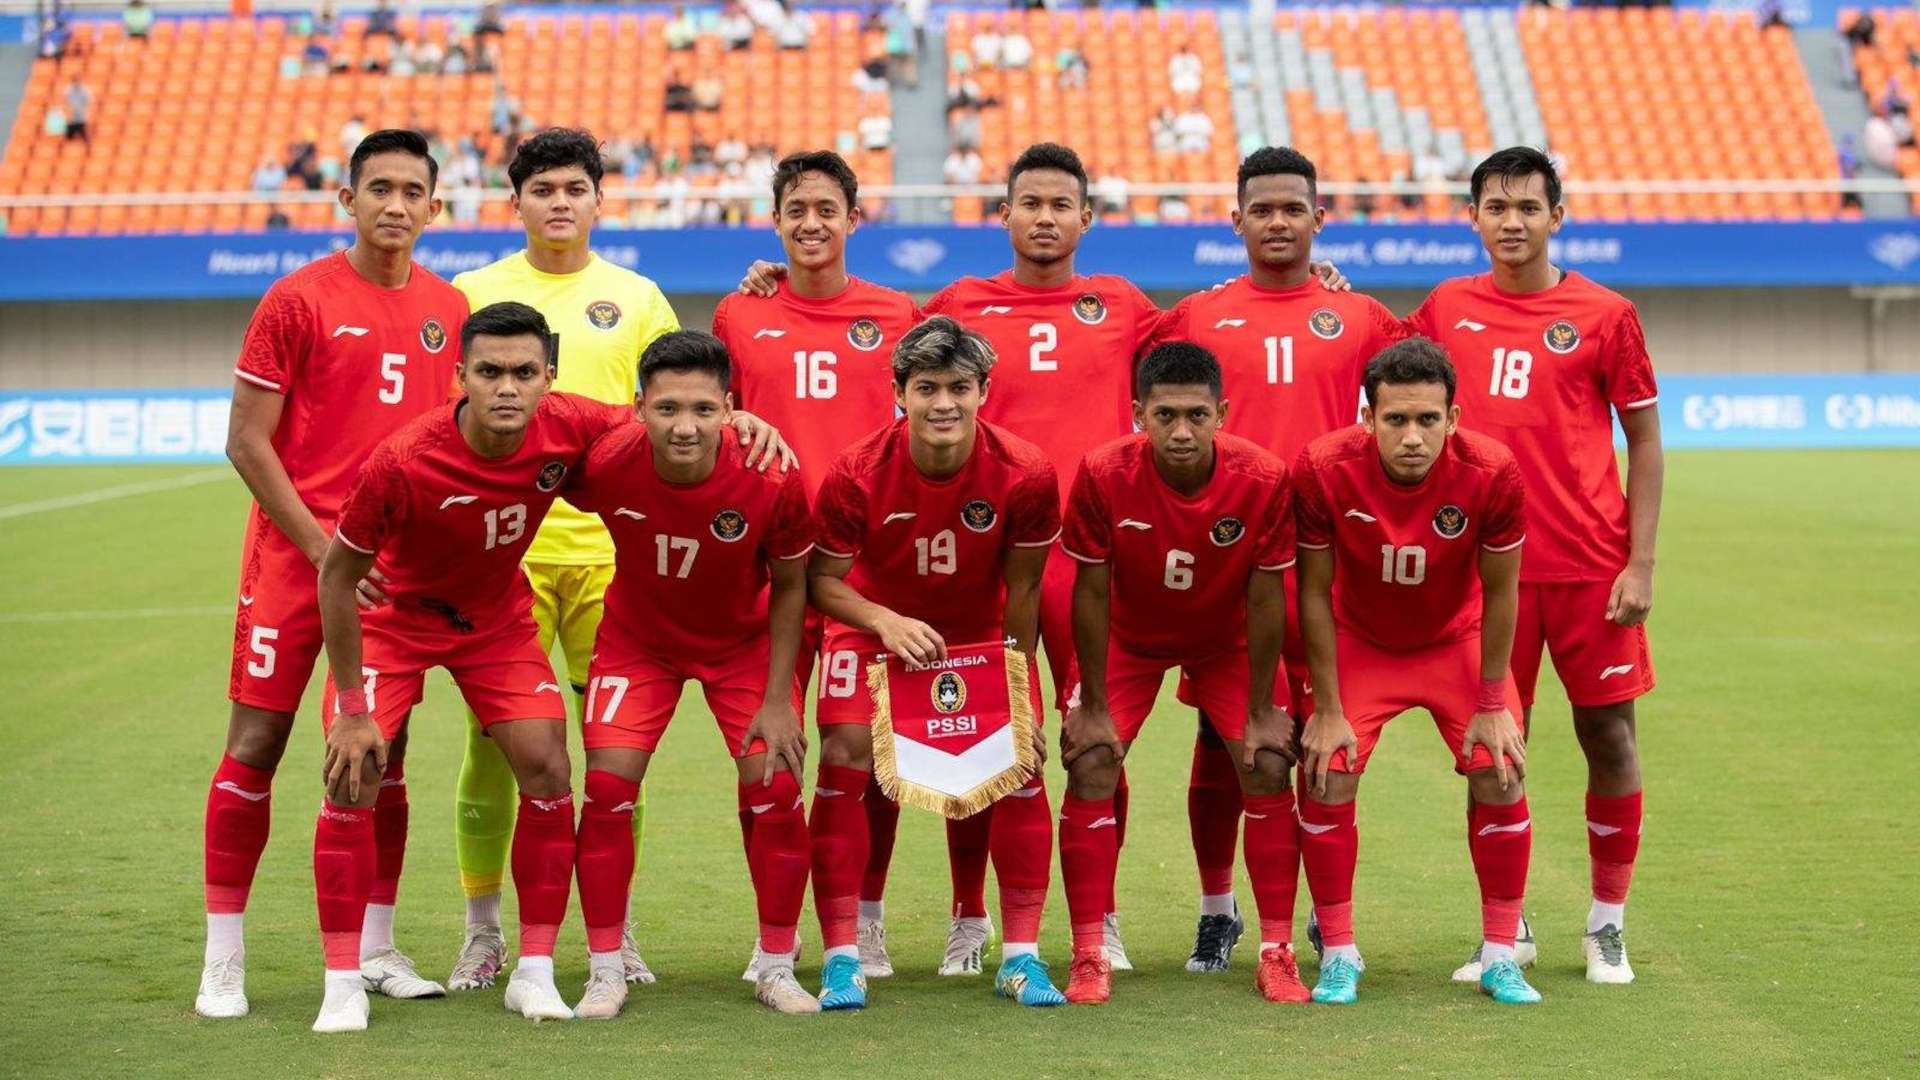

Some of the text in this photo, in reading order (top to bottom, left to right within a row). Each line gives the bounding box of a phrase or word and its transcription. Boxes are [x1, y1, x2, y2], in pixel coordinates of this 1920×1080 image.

[1029, 323, 1059, 371] 2
[1264, 336, 1294, 385] 11
[378, 353, 406, 404] 5
[793, 351, 838, 399] 16
[1489, 347, 1533, 399] 18
[484, 503, 527, 549] 13
[655, 534, 699, 579] 17
[916, 529, 957, 576] 19
[1164, 548, 1195, 590] 6
[1381, 544, 1427, 585] 10
[247, 625, 279, 679] 5
[820, 650, 859, 699] 19
[585, 676, 630, 723] 17
[927, 715, 977, 735] PSSI
